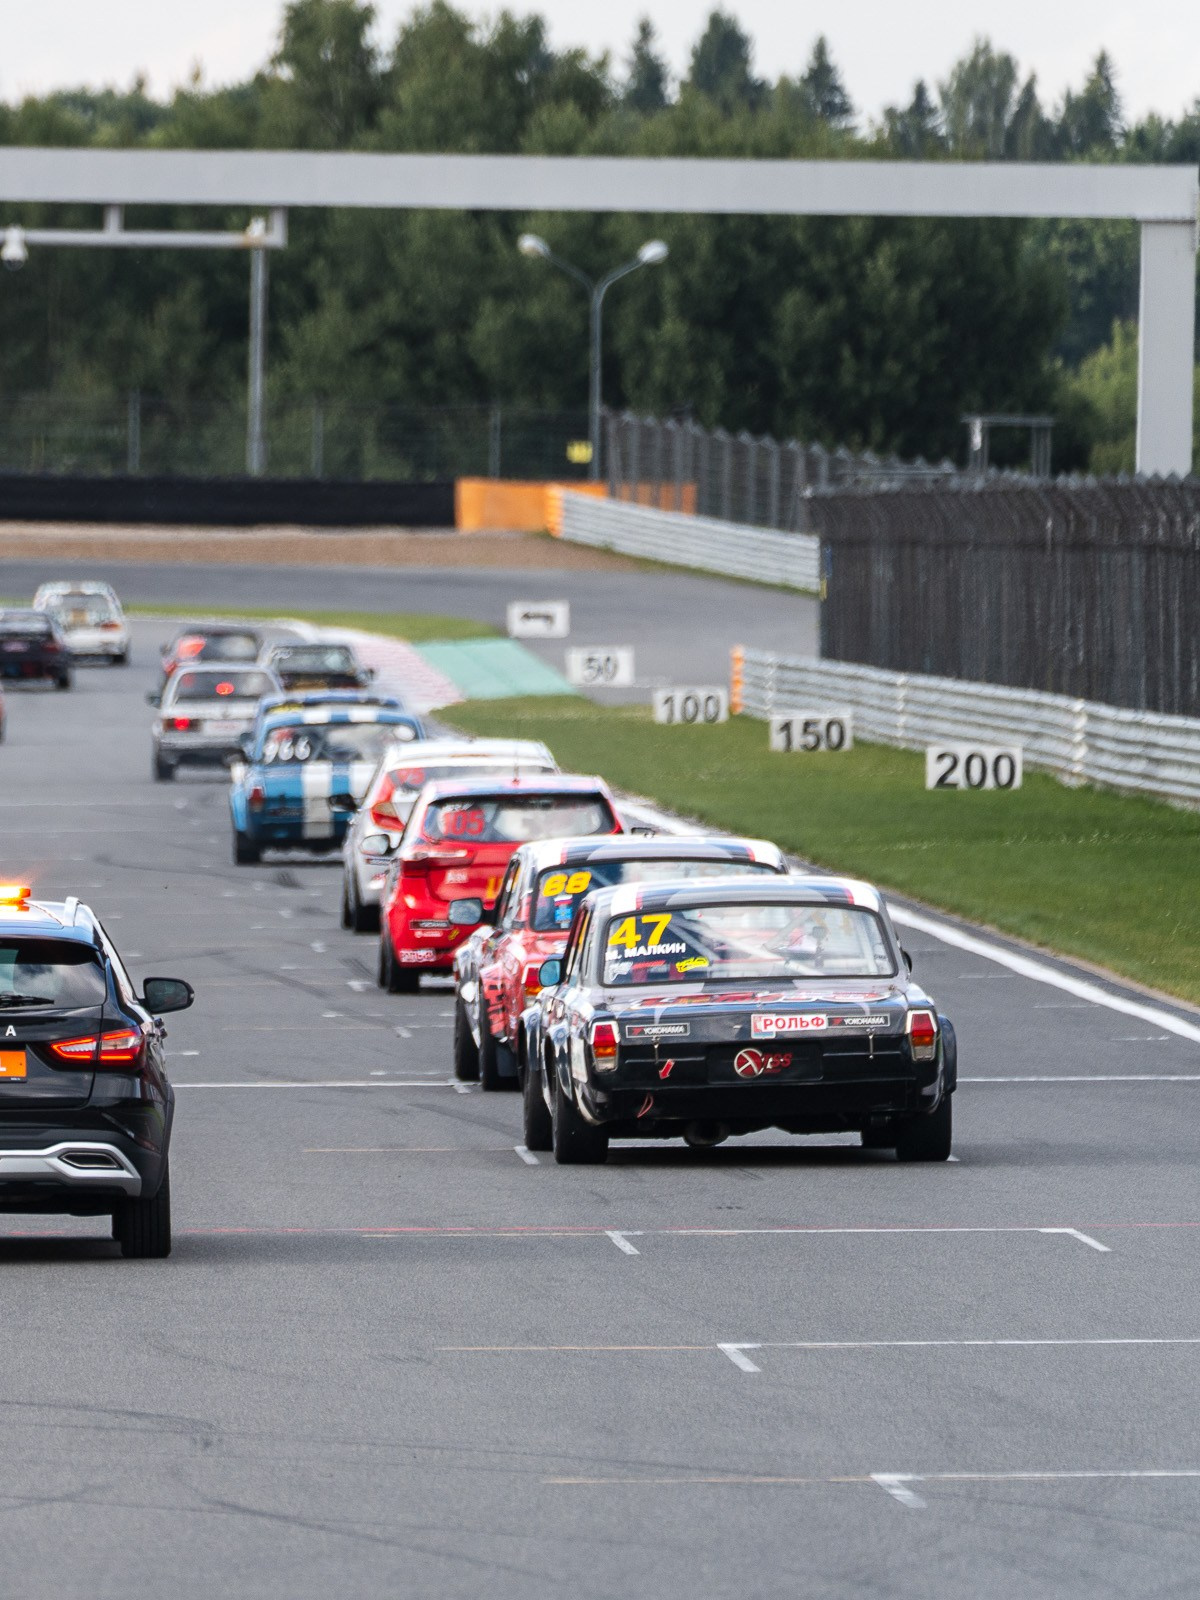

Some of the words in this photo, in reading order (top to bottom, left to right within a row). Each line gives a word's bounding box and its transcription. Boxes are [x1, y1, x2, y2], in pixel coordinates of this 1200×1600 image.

[584, 655, 619, 682] 50
[662, 694, 721, 724] 100
[778, 717, 846, 752] 150
[934, 751, 1016, 790] 200
[442, 808, 486, 836] 105
[608, 913, 672, 948] 47
[624, 943, 686, 958] МАЛКИН
[643, 1025, 685, 1035] YOKOHAMA
[763, 1016, 825, 1031] РОЛЬФ
[844, 1016, 885, 1026] YOKOHAMA
